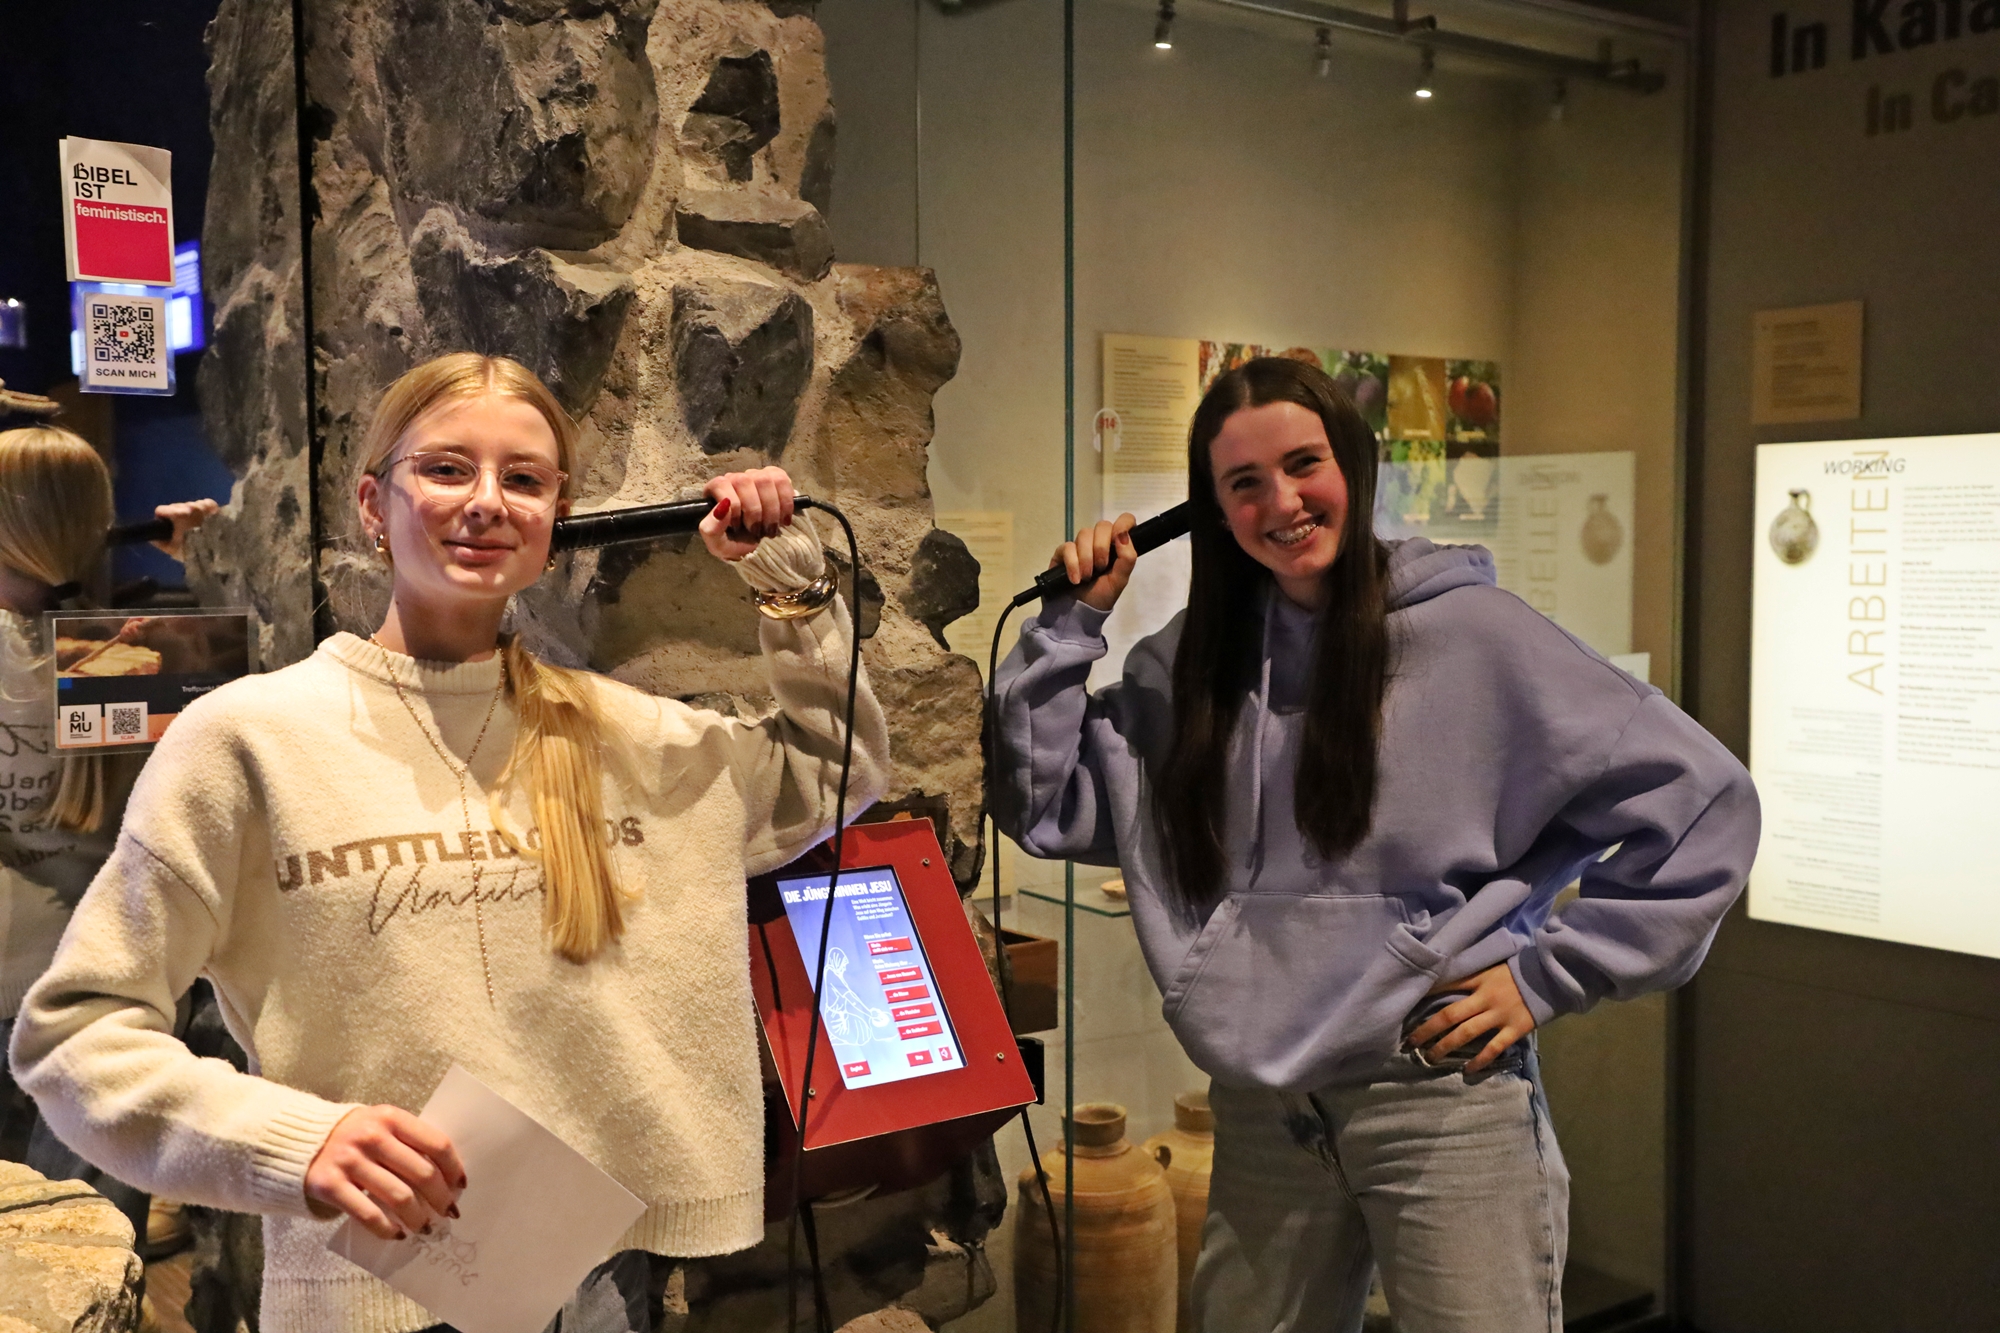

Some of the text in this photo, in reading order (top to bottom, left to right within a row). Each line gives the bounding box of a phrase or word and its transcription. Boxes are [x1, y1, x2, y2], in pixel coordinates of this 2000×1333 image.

[1770, 12, 1828, 77] In
[1864, 82, 1912, 137] In
[72, 162, 137, 186] BIBEL
[75, 181, 105, 200] IST
[75, 203, 166, 224] feministisch.
[96, 367, 156, 379] SCAN MICH
[1824, 459, 1906, 475] WORKING
[1847, 450, 1890, 696] ARBEITEN
[70, 722, 92, 733] MU
[783, 890, 802, 903] DIE
[869, 880, 892, 894] JESU
